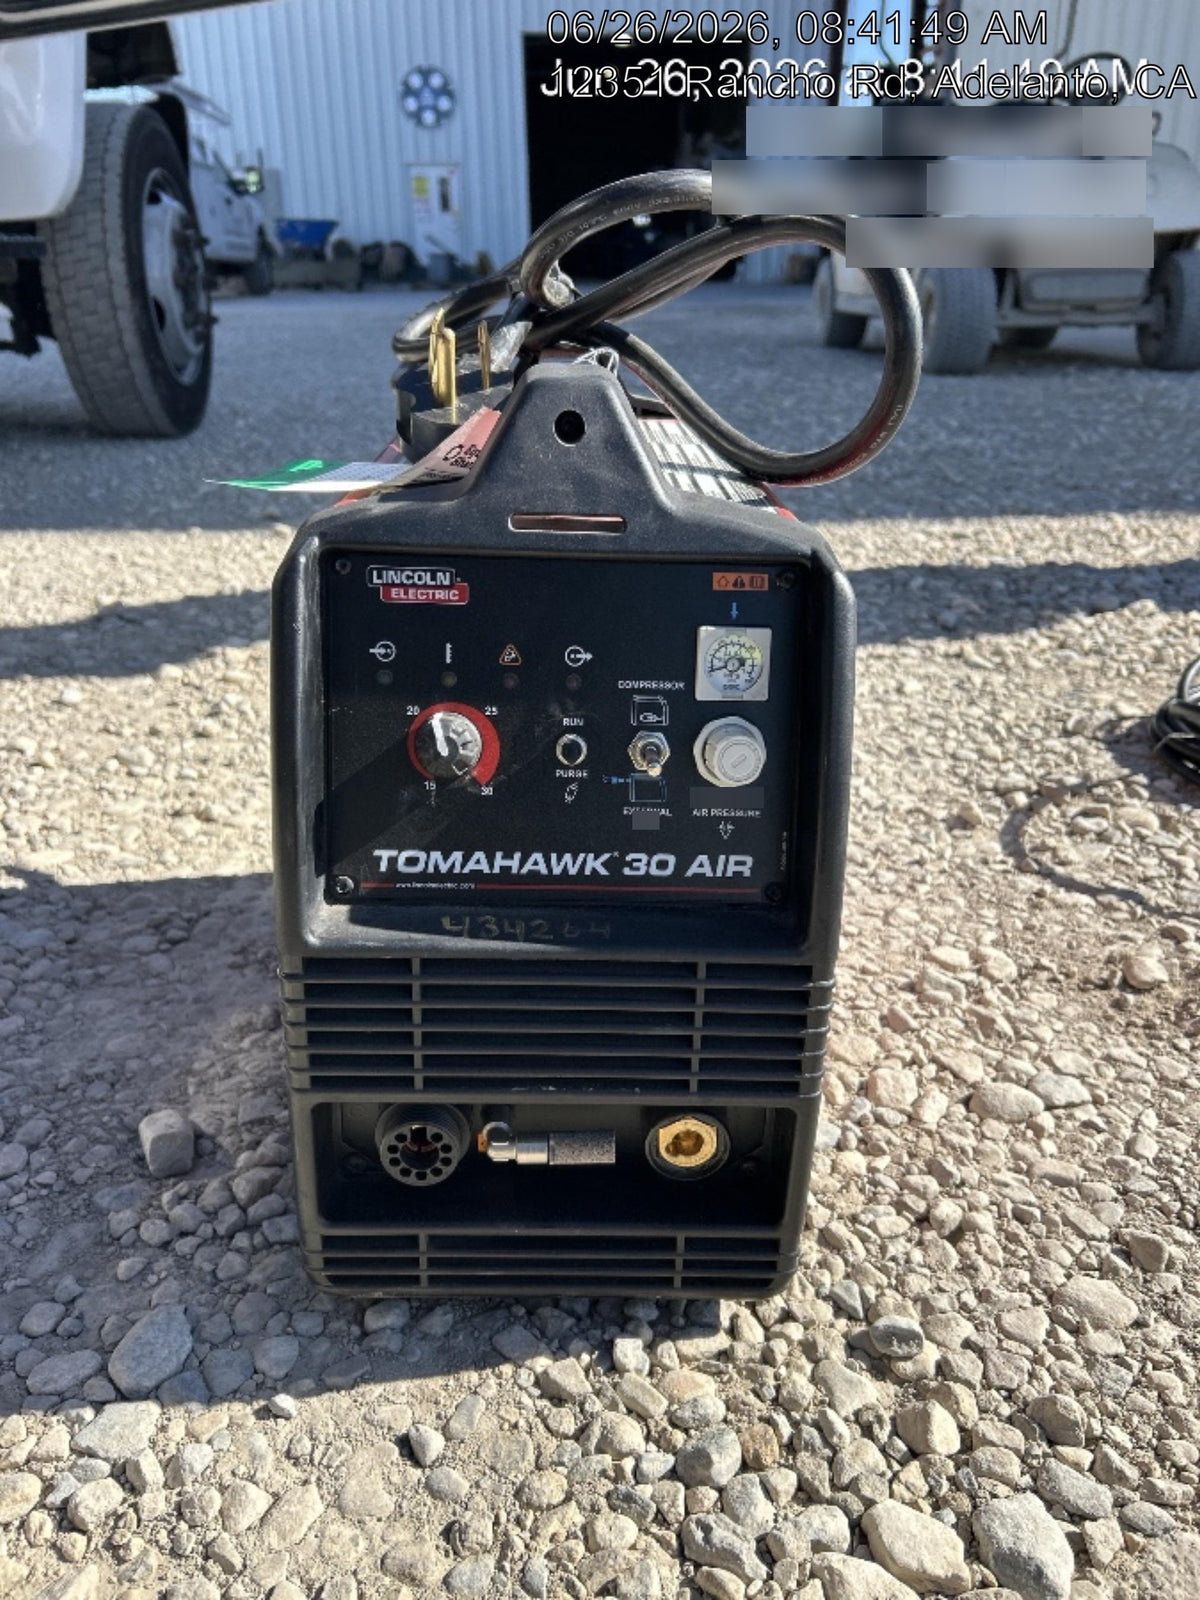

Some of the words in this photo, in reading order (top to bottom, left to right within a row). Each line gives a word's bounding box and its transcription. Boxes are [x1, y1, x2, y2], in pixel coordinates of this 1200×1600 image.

[372, 570, 450, 586] LINCOLN
[390, 587, 460, 601] ELECTRIC
[618, 680, 686, 690] COMPRESSOR
[406, 705, 421, 716] 20
[484, 706, 499, 716] 25
[563, 717, 584, 727] RUN
[555, 769, 588, 779] PURGE
[423, 780, 437, 790] 15
[480, 786, 494, 796] 30
[691, 807, 709, 818] AIR
[710, 808, 761, 818] PRESSURE
[622, 852, 677, 877] 30
[684, 853, 754, 878] AIR
